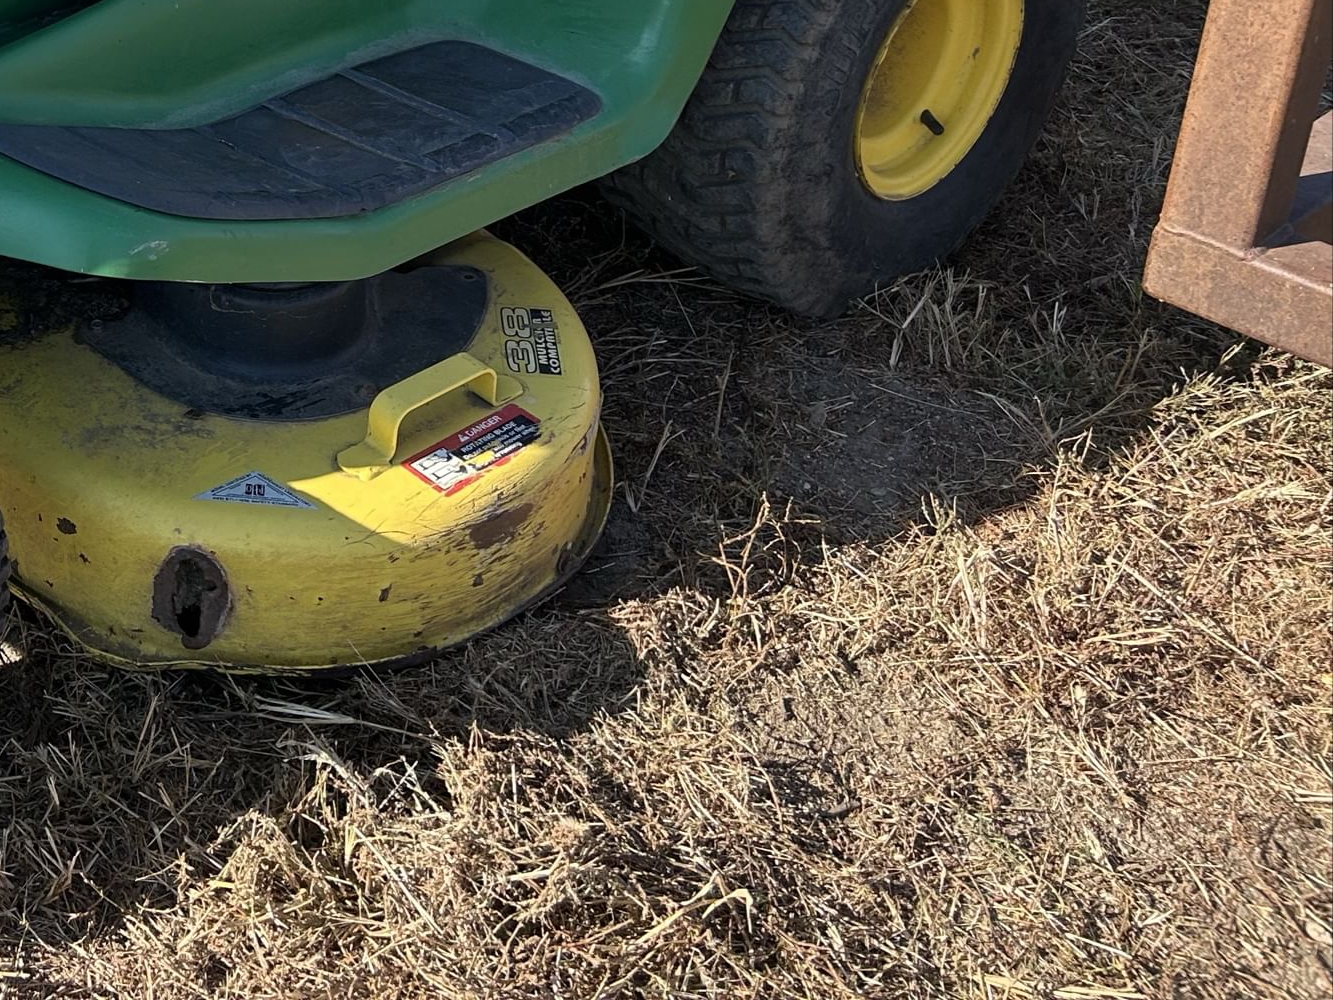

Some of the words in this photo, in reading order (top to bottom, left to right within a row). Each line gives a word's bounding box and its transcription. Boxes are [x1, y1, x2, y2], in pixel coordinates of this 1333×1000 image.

[500, 307, 537, 373] 38
[541, 310, 560, 374] COMPATILE
[460, 431, 495, 453] ROTATING
[493, 421, 517, 436] BLADE
[465, 415, 503, 437] DANGER
